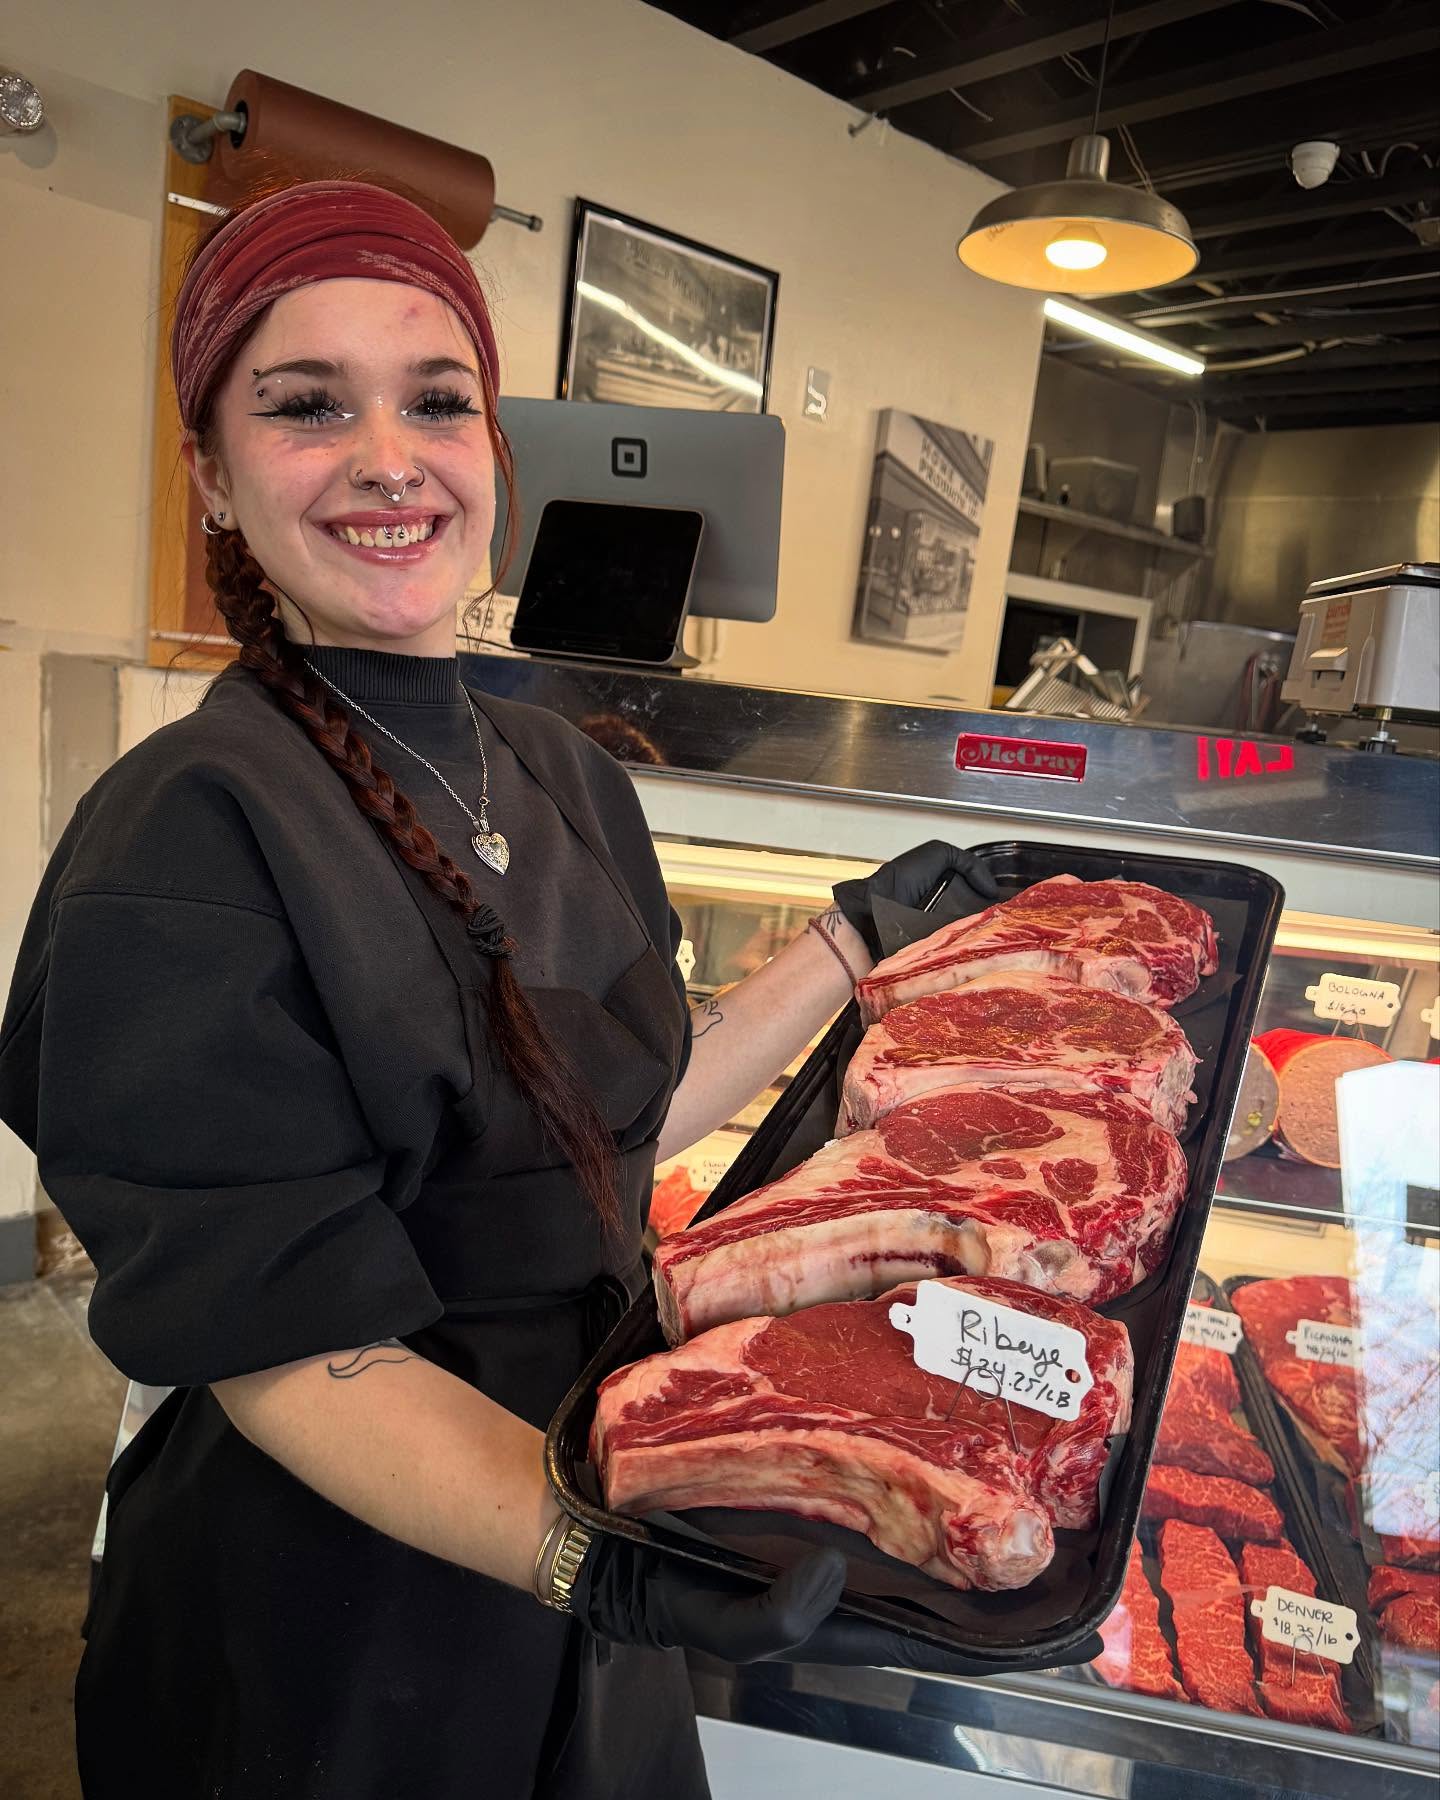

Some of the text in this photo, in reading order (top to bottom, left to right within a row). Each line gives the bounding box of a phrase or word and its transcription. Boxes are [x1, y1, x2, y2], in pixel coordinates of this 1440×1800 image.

[960, 742, 1080, 775] McCray
[1328, 982, 1385, 1000] BOLOGNA
[961, 1310, 1063, 1377] Ribeye
[1277, 1598, 1333, 1624] DENVER
